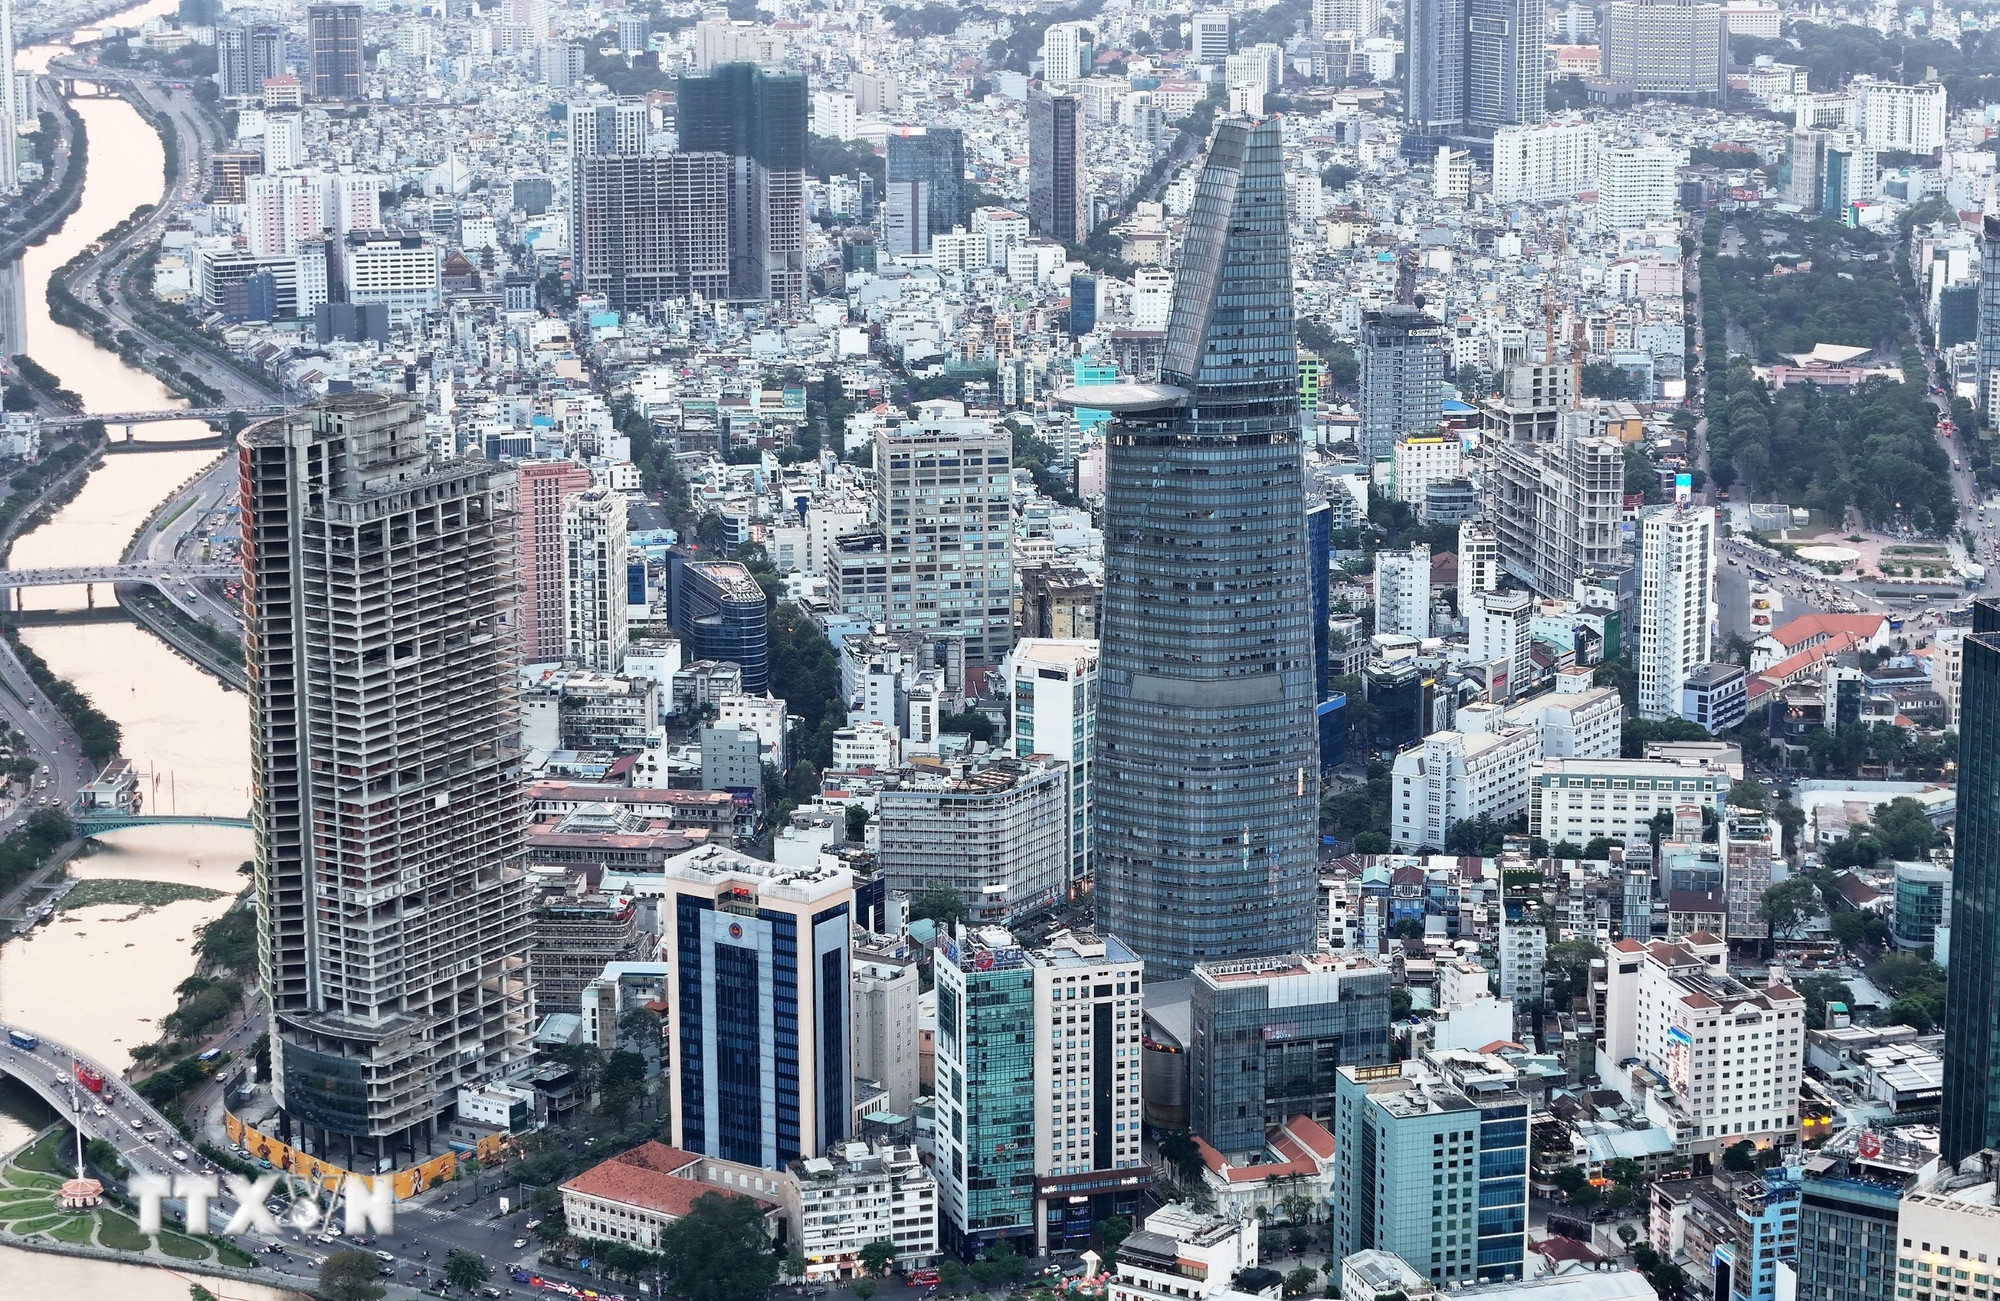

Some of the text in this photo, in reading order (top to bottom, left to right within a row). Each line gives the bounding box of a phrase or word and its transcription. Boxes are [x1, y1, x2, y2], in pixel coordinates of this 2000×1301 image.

[994, 948, 1024, 963] SCB
[1004, 1142, 1019, 1150] SCB
[1883, 1138, 1920, 1159] SCB
